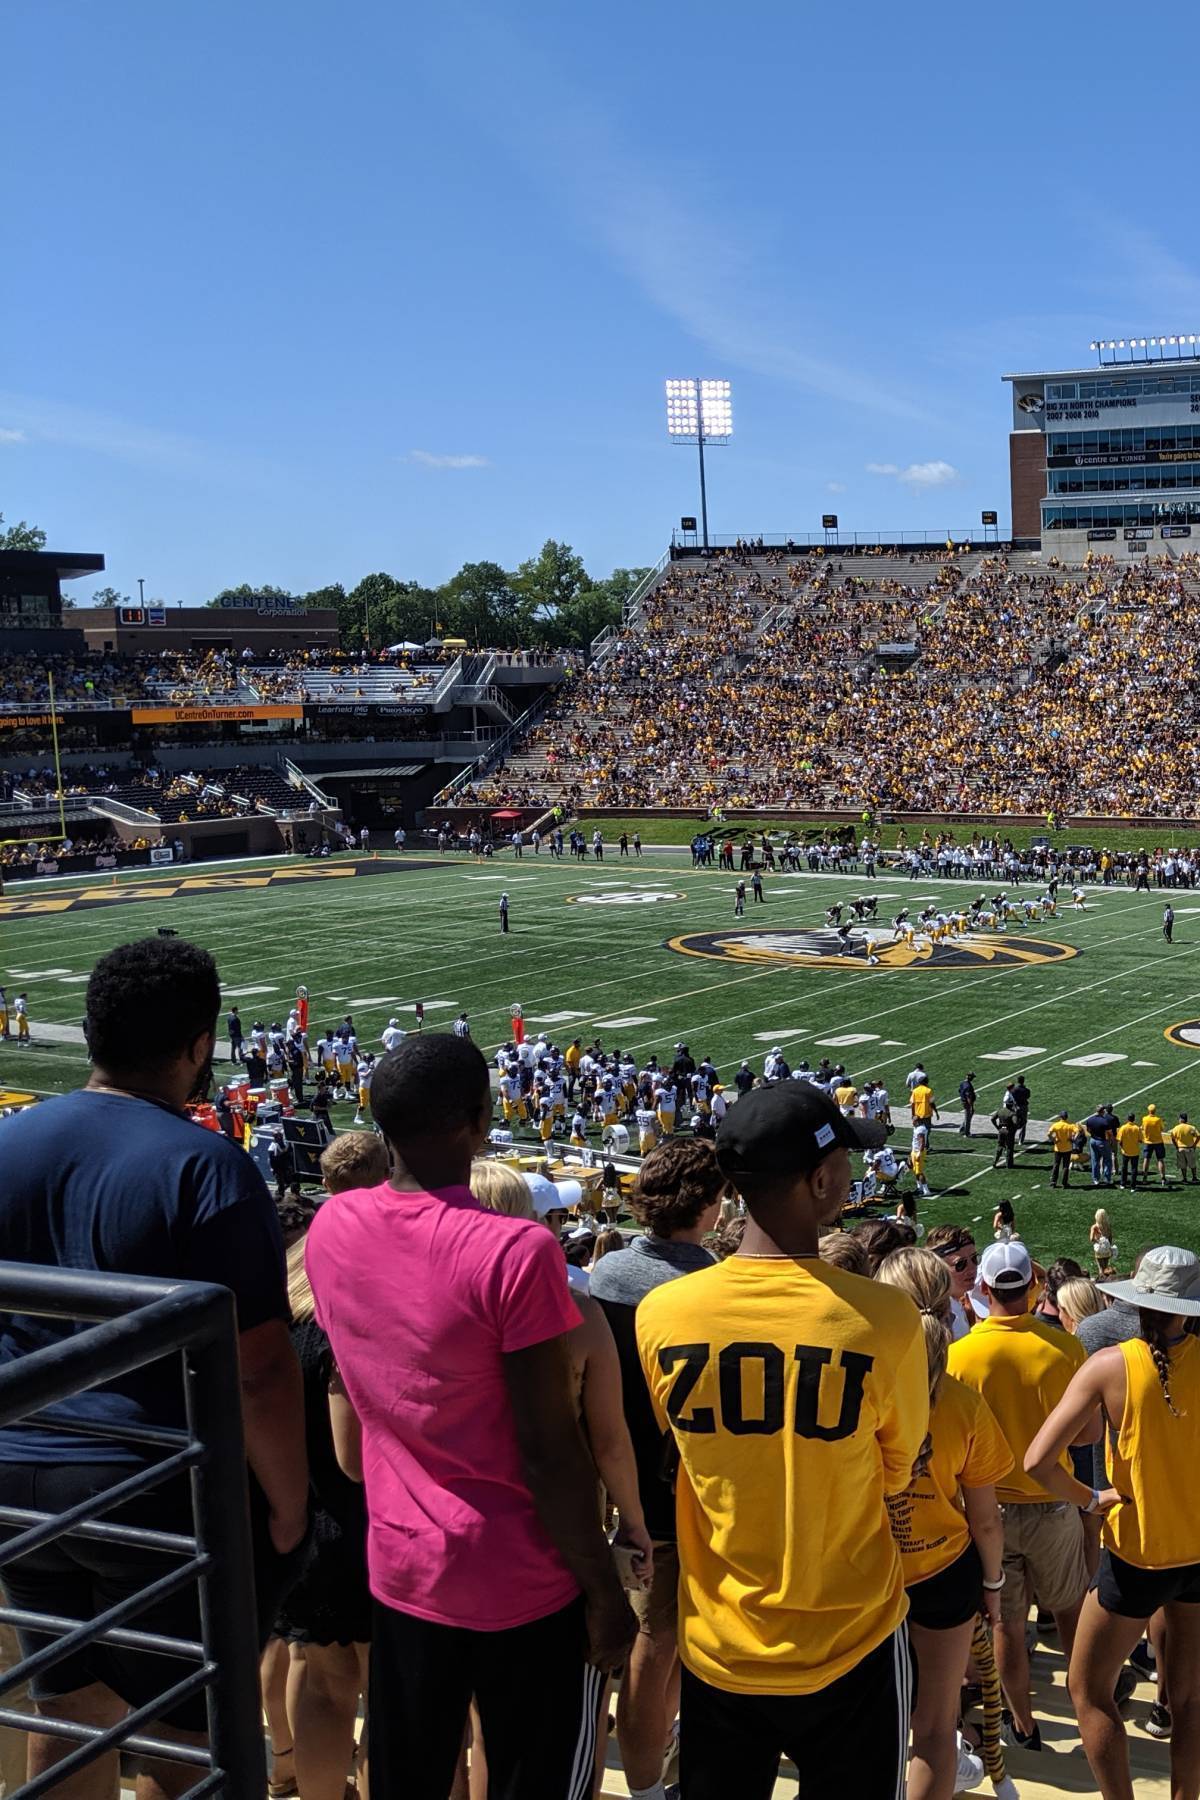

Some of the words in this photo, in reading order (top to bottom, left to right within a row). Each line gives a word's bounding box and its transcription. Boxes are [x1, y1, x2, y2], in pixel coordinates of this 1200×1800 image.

[1046, 402, 1058, 411] BIG
[1059, 401, 1069, 410] XII
[1069, 400, 1094, 410] NORTH
[1095, 398, 1137, 408] CHAMPIONS
[1046, 411, 1063, 421] 2007
[1083, 410, 1099, 419] 2010
[257, 606, 309, 617] Corporation
[318, 704, 353, 714] Learfield
[175, 709, 255, 721] UCentreOnTurner.com
[658, 1341, 874, 1442] ZOU
